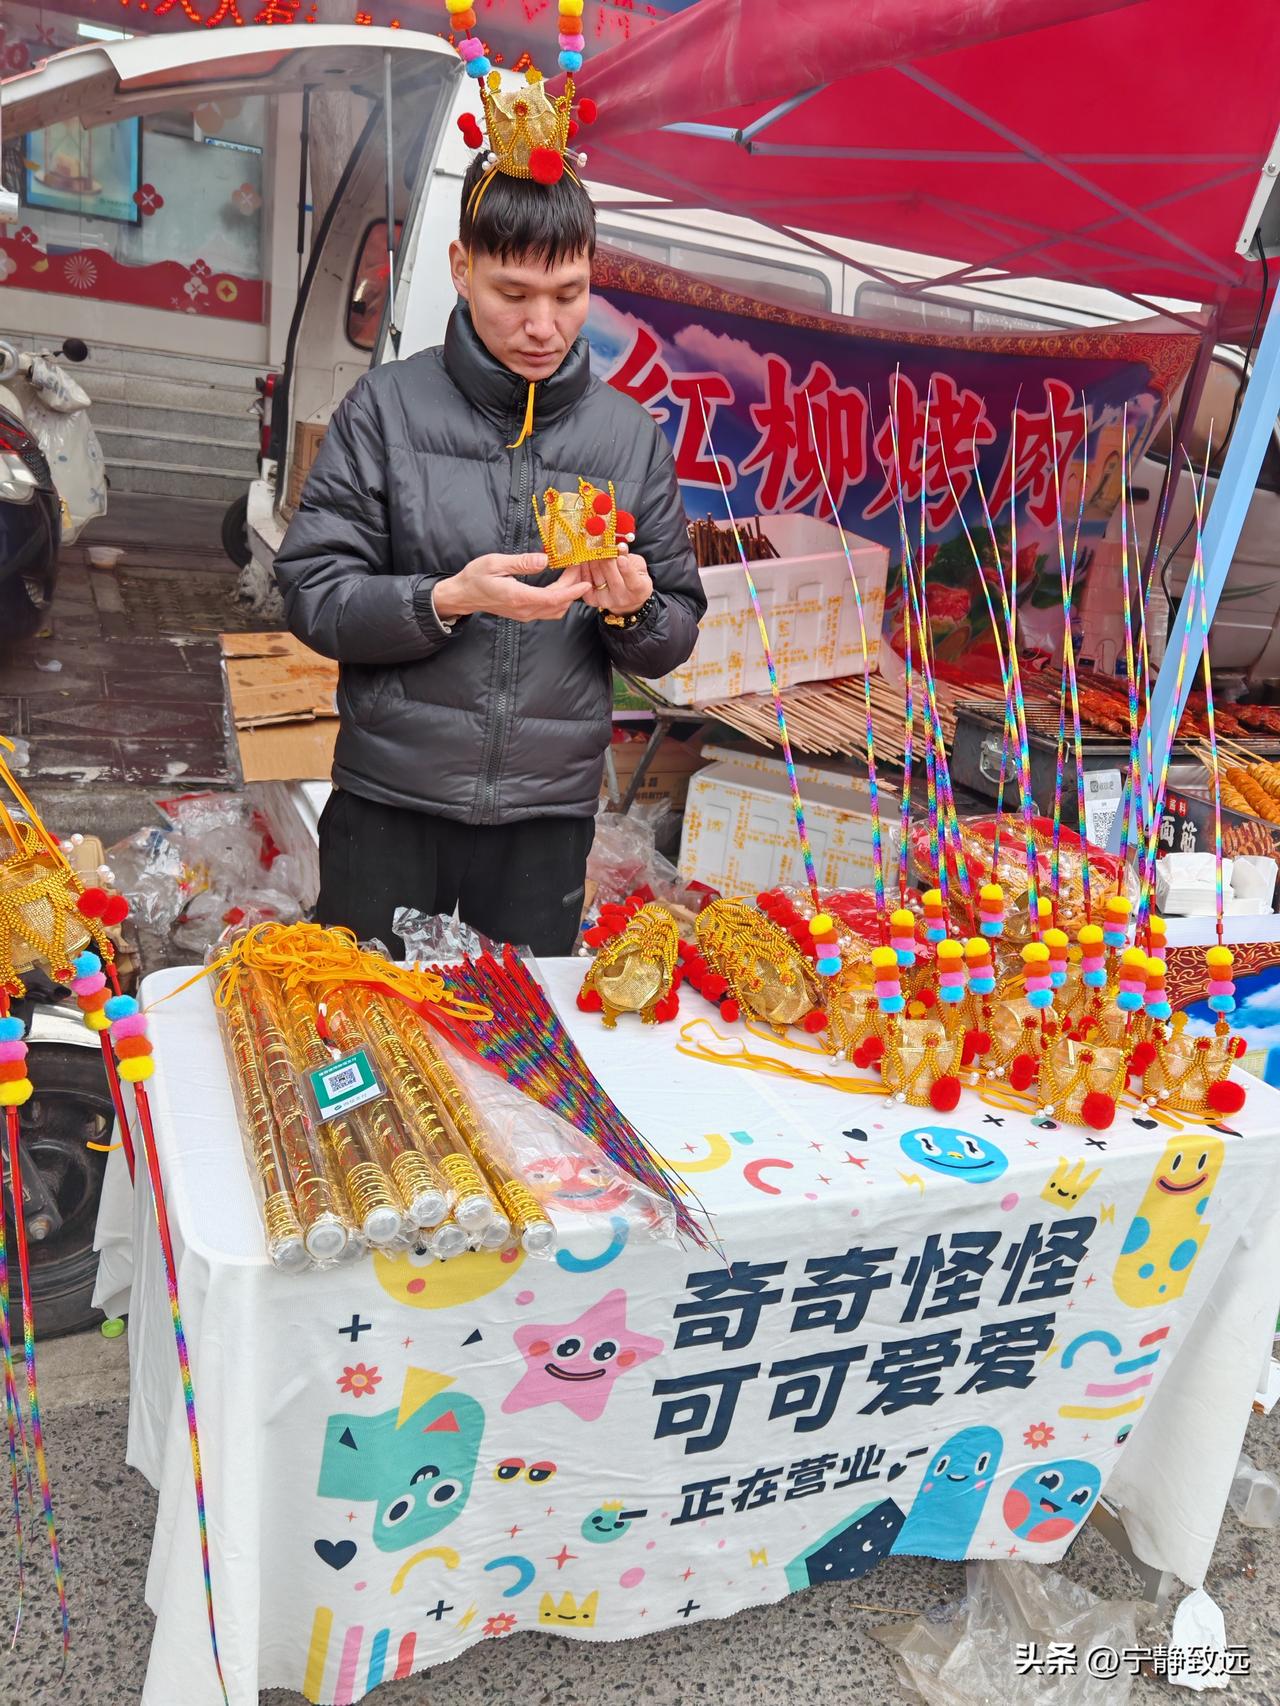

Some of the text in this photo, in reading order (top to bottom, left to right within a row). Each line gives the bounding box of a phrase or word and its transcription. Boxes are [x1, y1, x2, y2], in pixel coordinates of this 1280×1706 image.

[605, 327, 1087, 530] 红柳烤肉
[672, 1216, 1098, 1351] 奇奇怪怪
[651, 1312, 1056, 1455] 可可爱爱
[670, 1444, 887, 1526] 正在营业
